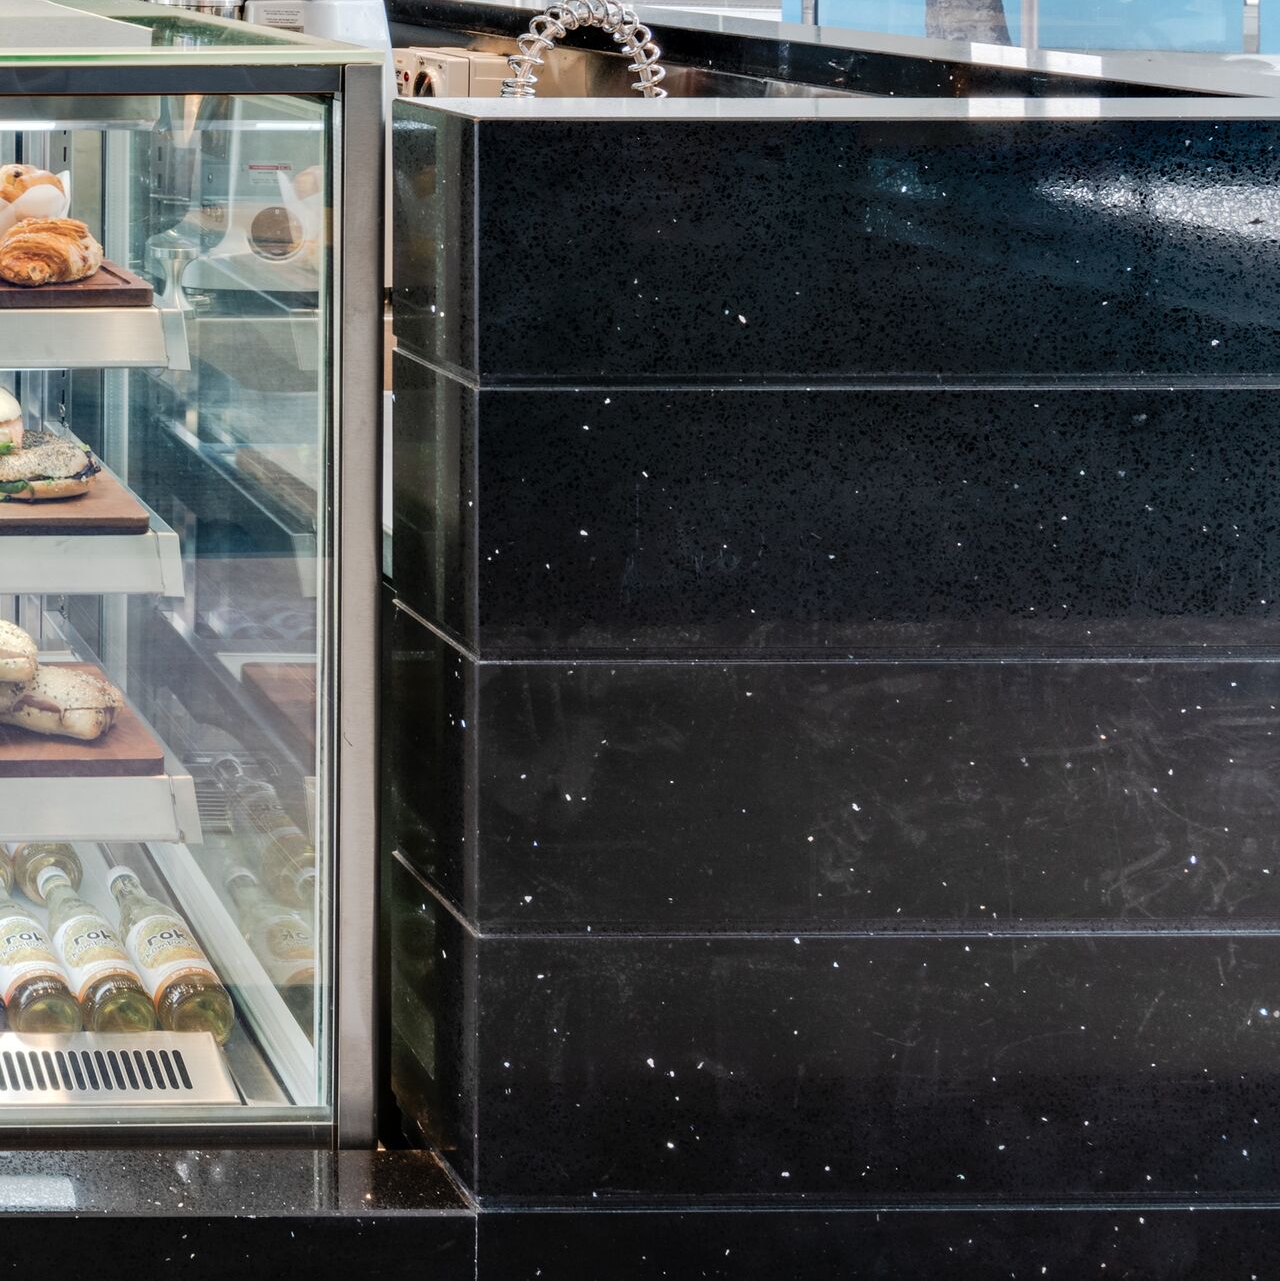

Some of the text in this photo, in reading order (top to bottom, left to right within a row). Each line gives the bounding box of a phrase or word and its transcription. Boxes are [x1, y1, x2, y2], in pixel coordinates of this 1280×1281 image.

[5, 931, 44, 946] rok
[74, 930, 113, 945] rok
[147, 929, 186, 946] rok
